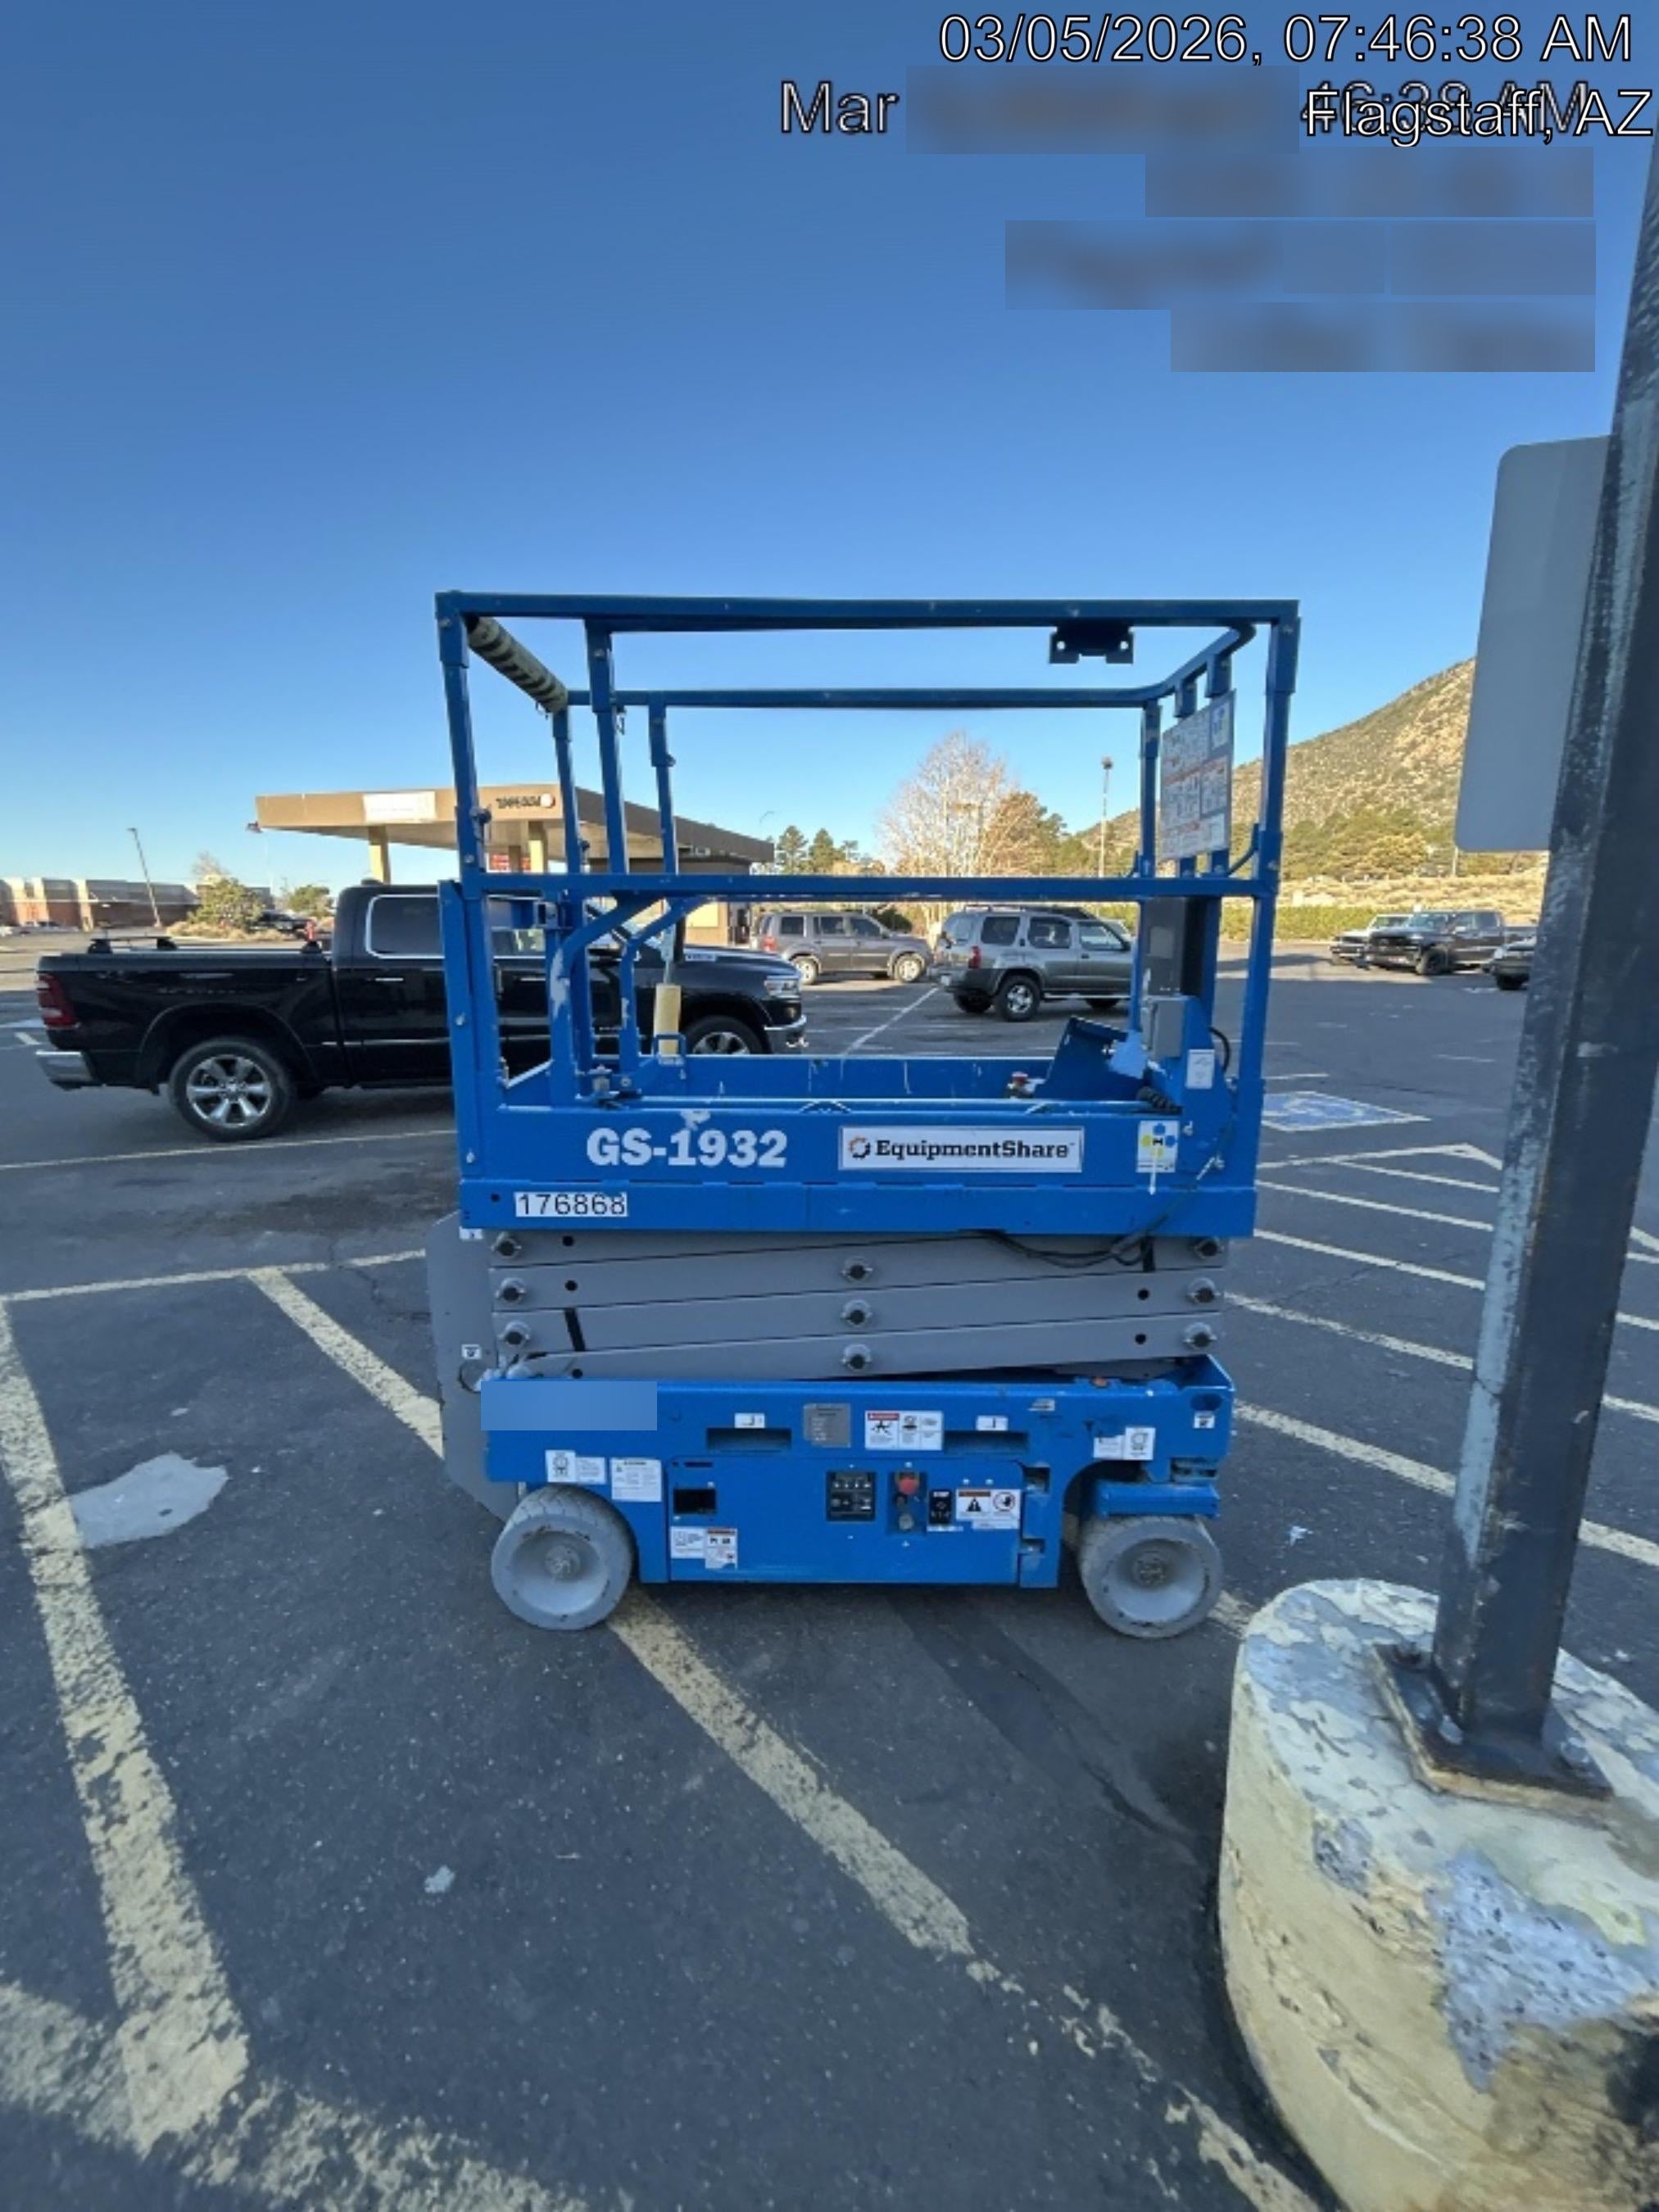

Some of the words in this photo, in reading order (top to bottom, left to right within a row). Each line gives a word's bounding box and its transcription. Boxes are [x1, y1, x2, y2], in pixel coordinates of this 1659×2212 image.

[587, 1127, 788, 1167] GS-1932
[875, 1140, 1069, 1161] EquipmentShare
[519, 1193, 625, 1215] 176868
